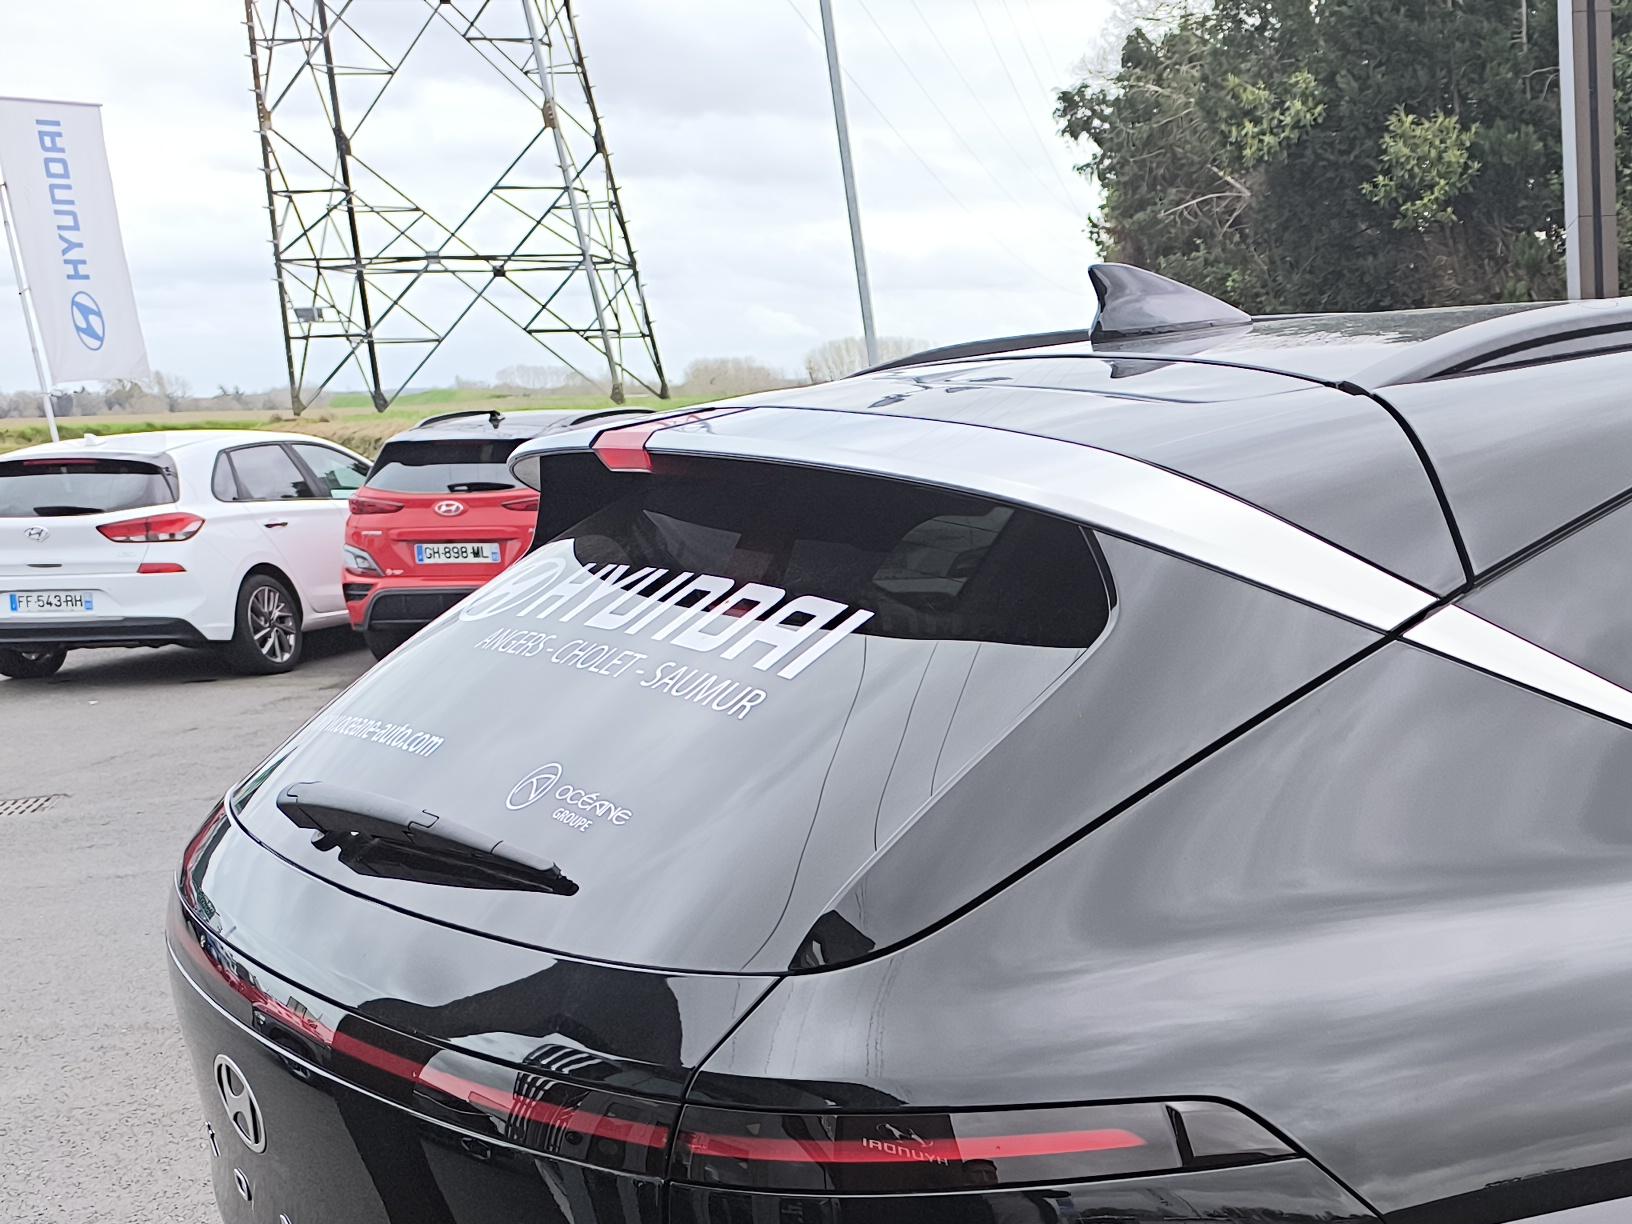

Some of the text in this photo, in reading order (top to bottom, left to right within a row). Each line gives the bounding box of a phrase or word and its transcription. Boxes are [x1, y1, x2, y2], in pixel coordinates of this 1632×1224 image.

[35, 119, 90, 280] HYUNDAI
[424, 546, 489, 559] GH-898-ML
[17, 594, 83, 608] FF-543-RH
[517, 562, 875, 680] HYUNDAI
[474, 628, 557, 657] ANGERS
[551, 639, 649, 678] CHOLET
[639, 661, 768, 720] SAUMUR
[552, 807, 593, 832] GROUPE
[555, 784, 633, 825] OCÉANE
